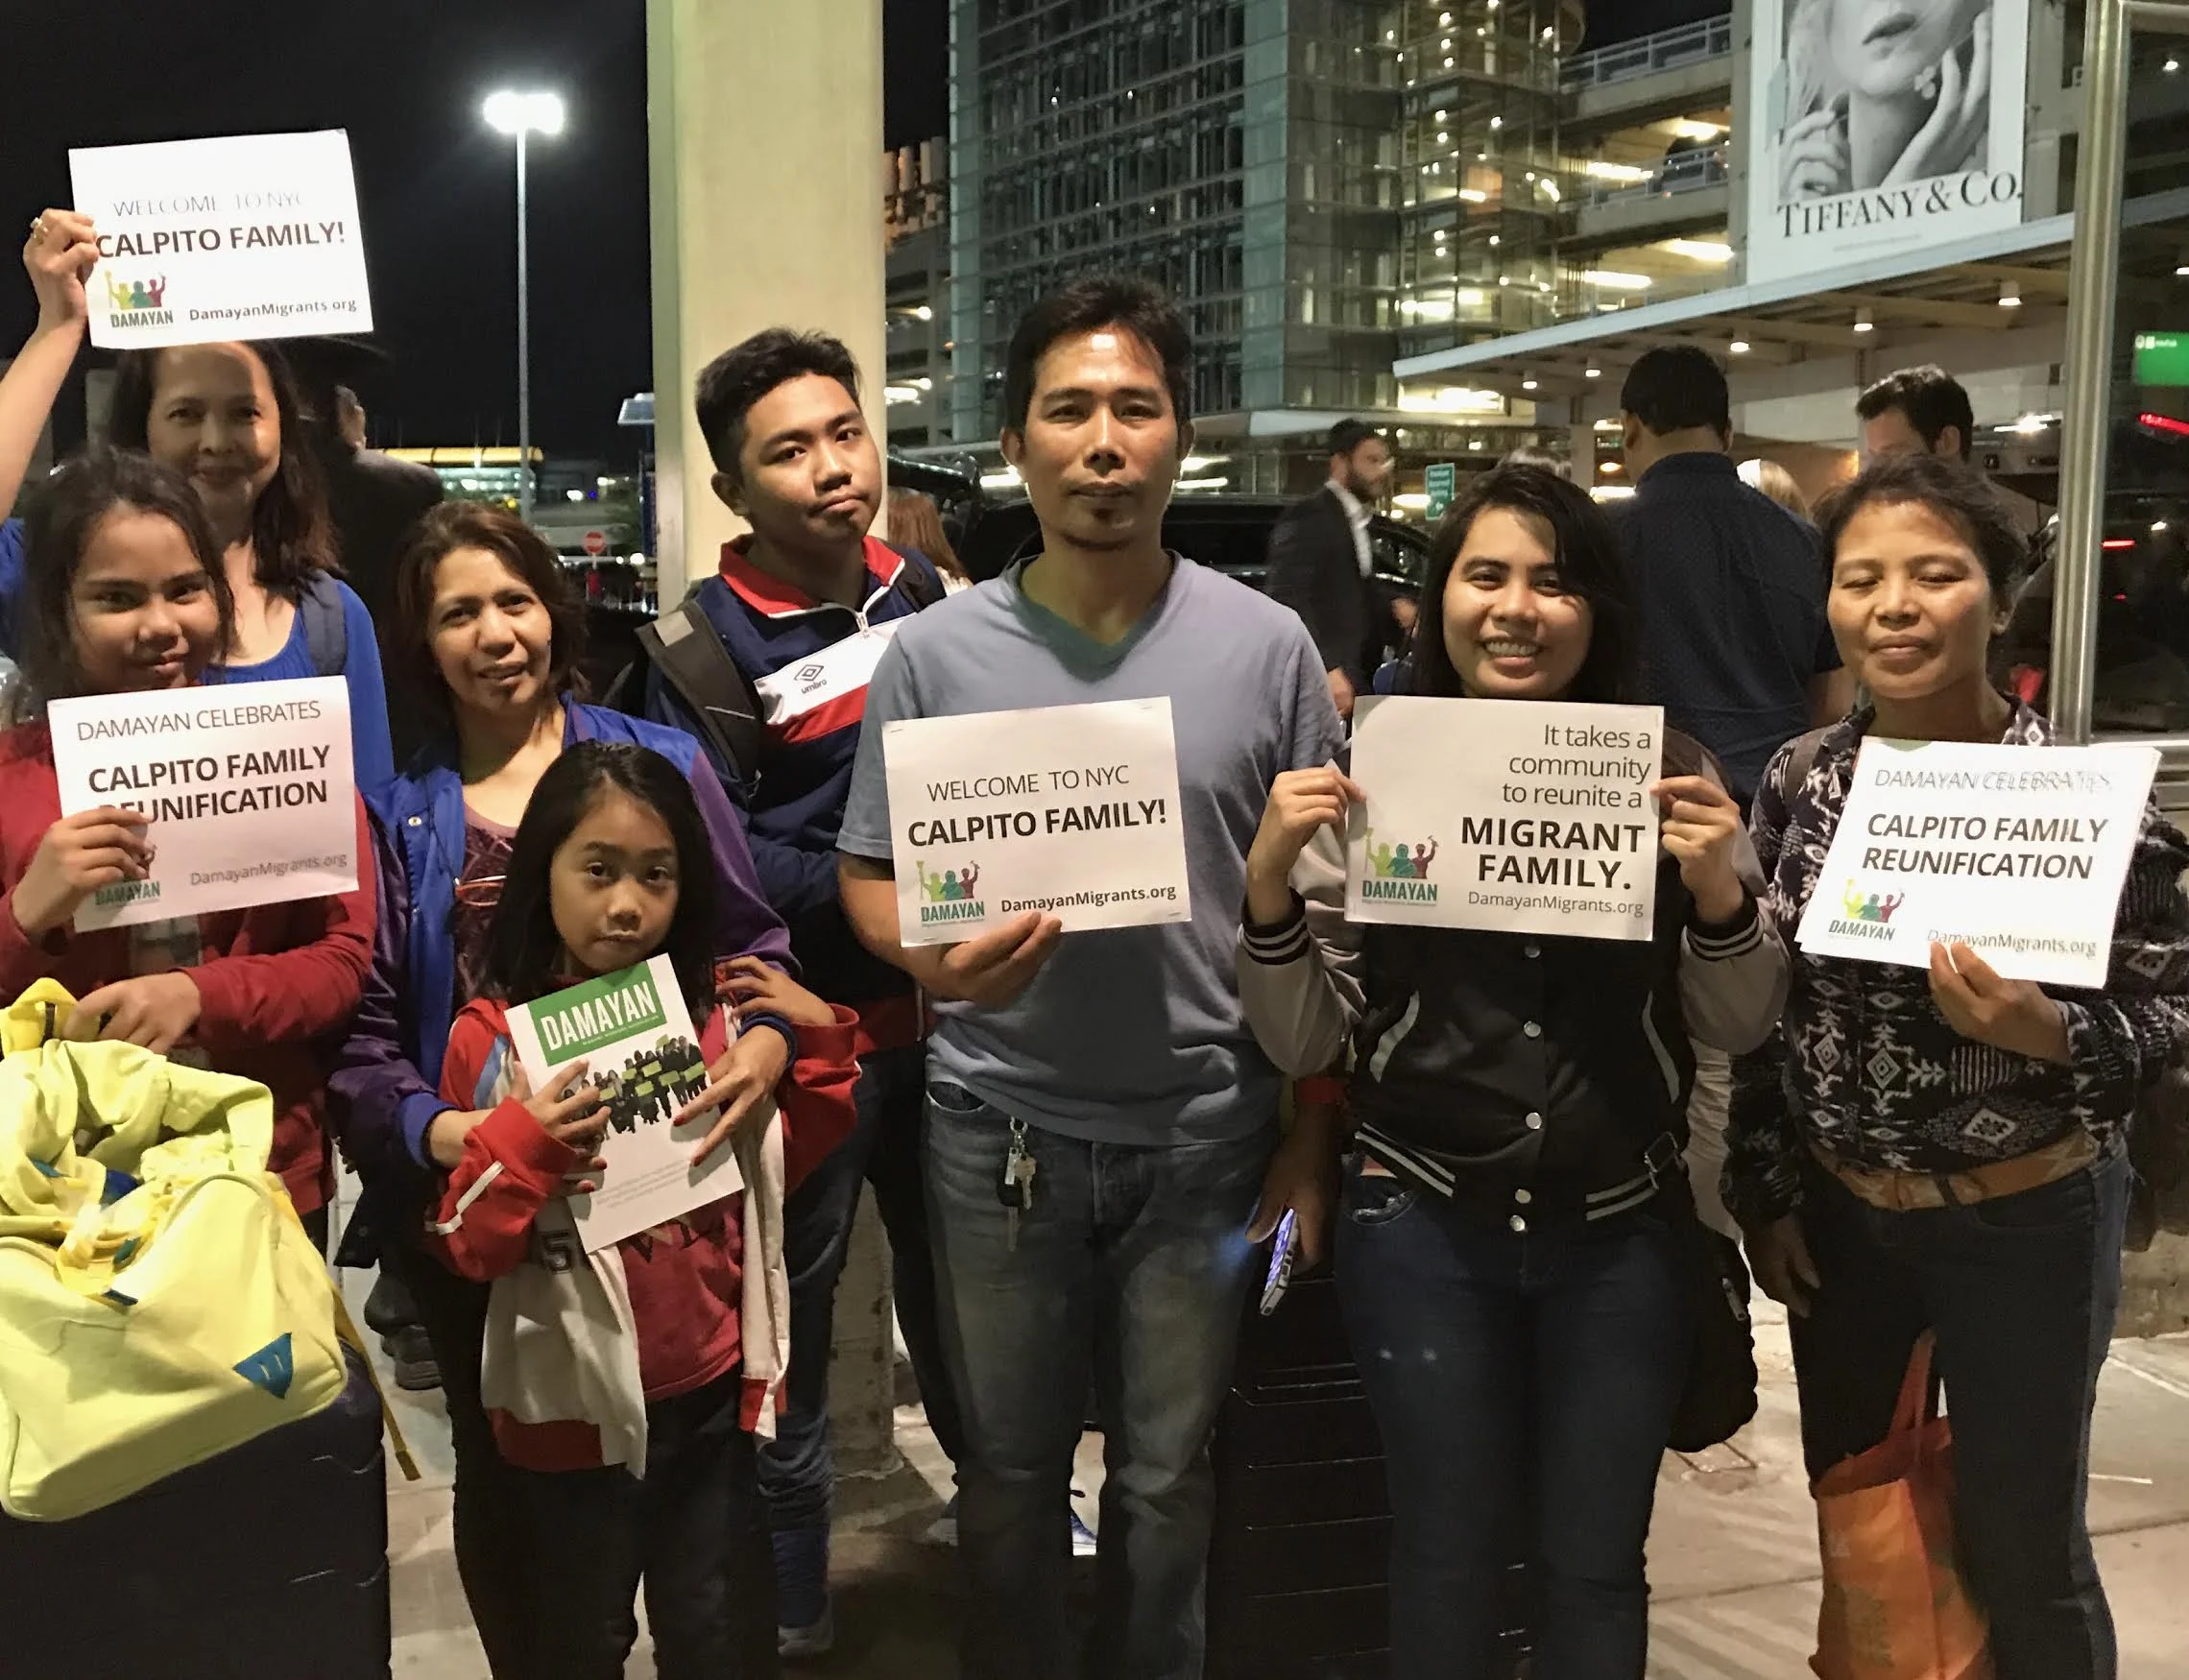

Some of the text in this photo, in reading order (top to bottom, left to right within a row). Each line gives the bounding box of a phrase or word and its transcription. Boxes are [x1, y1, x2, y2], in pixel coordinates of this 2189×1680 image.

[1777, 170, 2022, 238] TIFFANY & CO.
[95, 221, 345, 258] CALPITO FAMILY!
[110, 310, 174, 328] DAMAYAN
[189, 300, 357, 322] DamayanMigrantsorg
[801, 678, 828, 694] umbro
[78, 700, 322, 740] DAMAYAN CELEBRATES
[1544, 724, 1651, 750] It takes a
[88, 744, 330, 793] CALPITO FAMILY
[926, 764, 1130, 803] WELCOME TO NYC
[1509, 755, 1651, 785] community
[1874, 769, 1979, 790] DAMAYAN
[100, 780, 327, 823] UNIFICATION
[1503, 783, 1643, 808] to reunite a
[907, 798, 1167, 847] CALPITO FAMILY!
[1461, 816, 1647, 853] MIGRANT
[1867, 813, 2109, 844] CALPITO FAMILY
[190, 853, 349, 886] DamayanMigrants.org
[1479, 853, 1632, 890] FAMILY.
[1862, 847, 2094, 879] REUNIFICATION
[95, 881, 161, 905] DAMAYAN
[1000, 884, 1177, 913] DamayanMigrants.org
[1361, 880, 1438, 901] DAMAYAN
[1468, 891, 1645, 918] DamayanMigrants.org
[920, 900, 985, 922] DAMAYAN
[1828, 919, 1897, 942] DAMAYAN
[541, 980, 657, 1051] DAMAYAN
